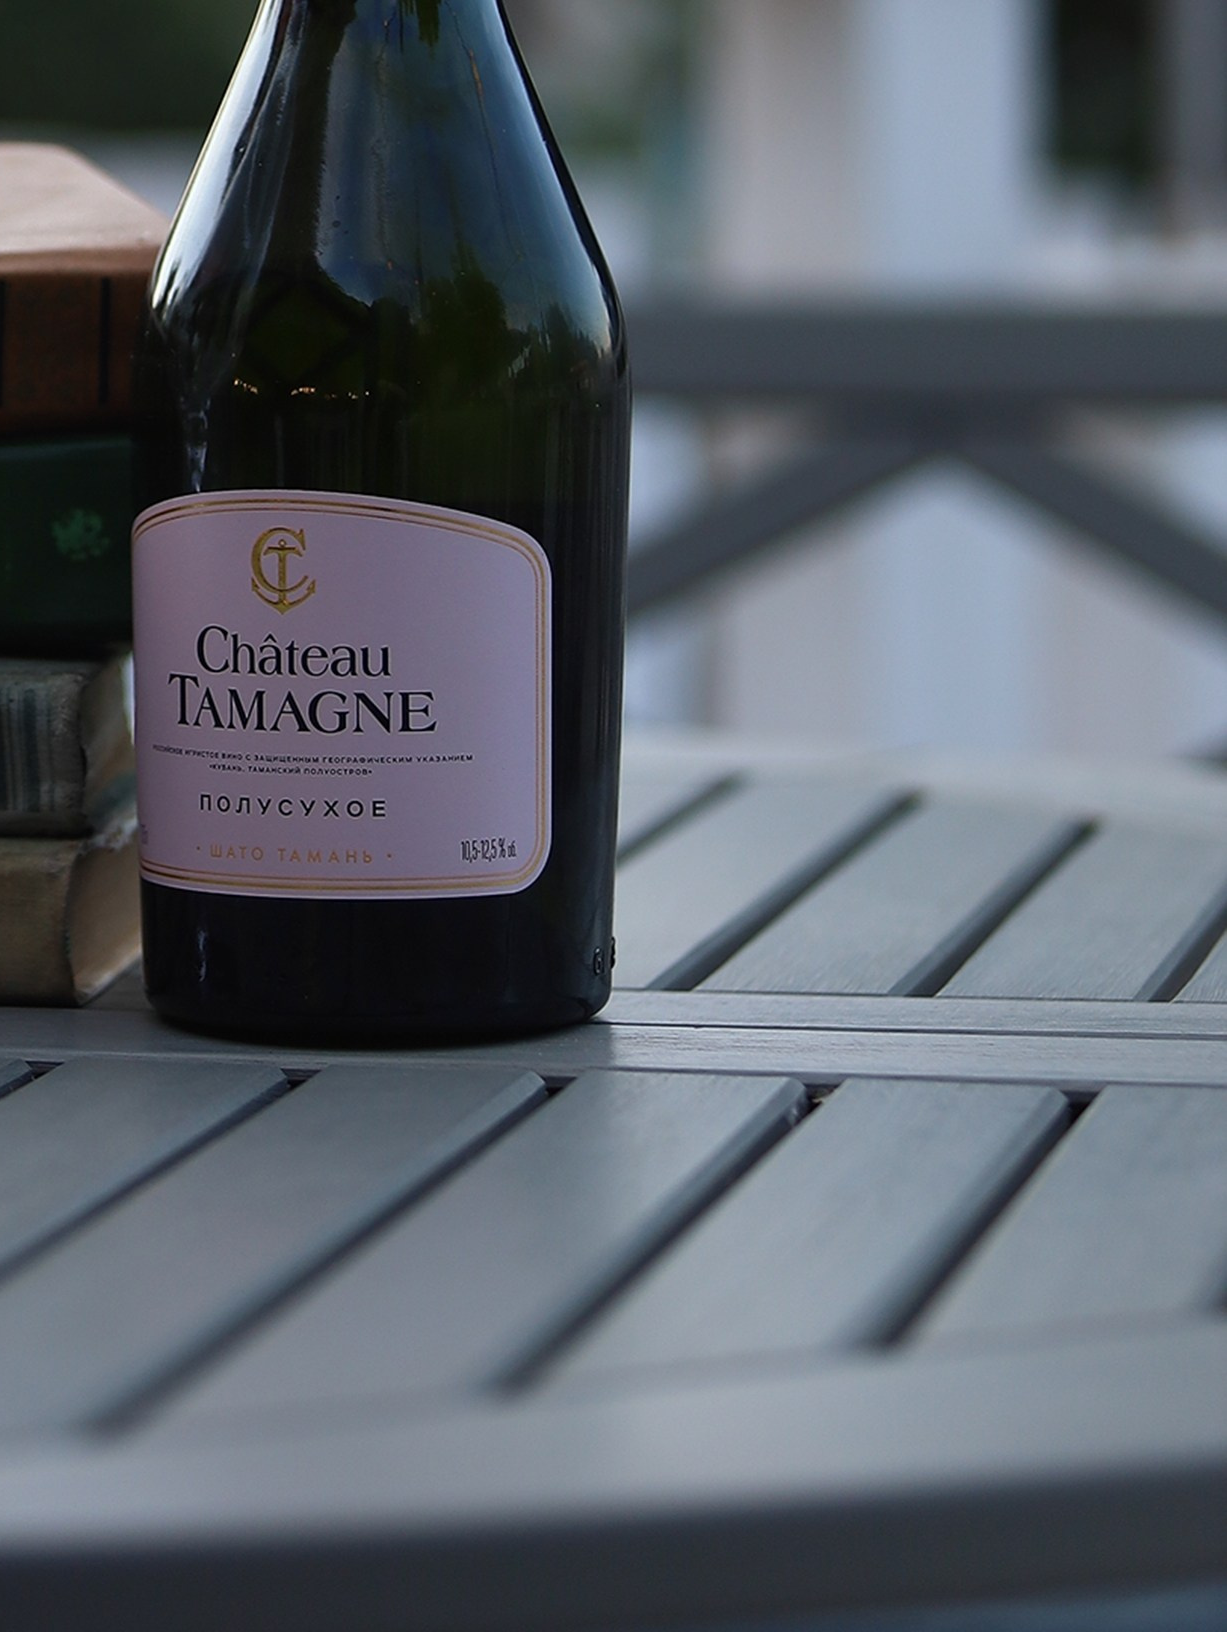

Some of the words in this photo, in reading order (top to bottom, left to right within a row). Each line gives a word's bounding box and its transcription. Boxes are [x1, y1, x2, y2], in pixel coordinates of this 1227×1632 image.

[196, 624, 392, 677] Château
[169, 673, 438, 734] TAMAGNE
[184, 749, 220, 759] ИГРИСТОЕ
[221, 752, 243, 761] ВИНО
[254, 754, 320, 764] ЗАЩИЩЕННЫМ
[322, 755, 414, 765] ГЕОГРАФИЧЕСКИМ
[416, 753, 474, 764] УКАЗАНИЕМ
[199, 793, 386, 818] ПОЛУСУХОЕ
[209, 842, 264, 862] ШАТО
[277, 845, 374, 865] ТАМАНЬ
